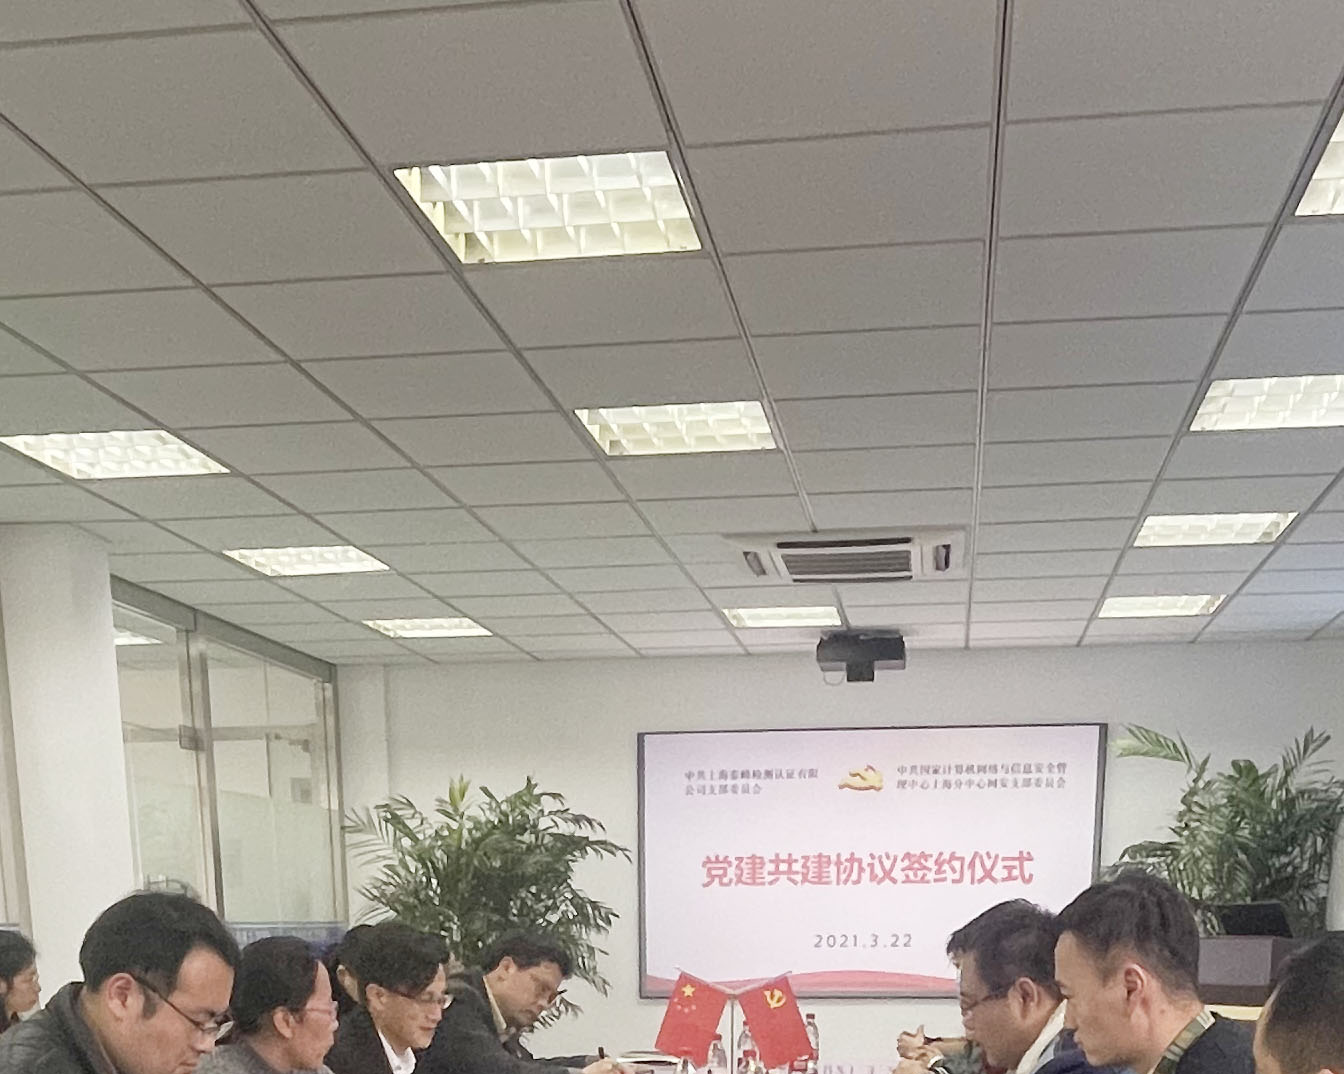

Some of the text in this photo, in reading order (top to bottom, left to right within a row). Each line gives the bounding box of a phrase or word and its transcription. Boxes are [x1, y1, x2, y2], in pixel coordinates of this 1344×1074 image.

[701, 850, 1034, 888] 党建共建协议签约仪式
[813, 933, 913, 949] 2021.3.22
